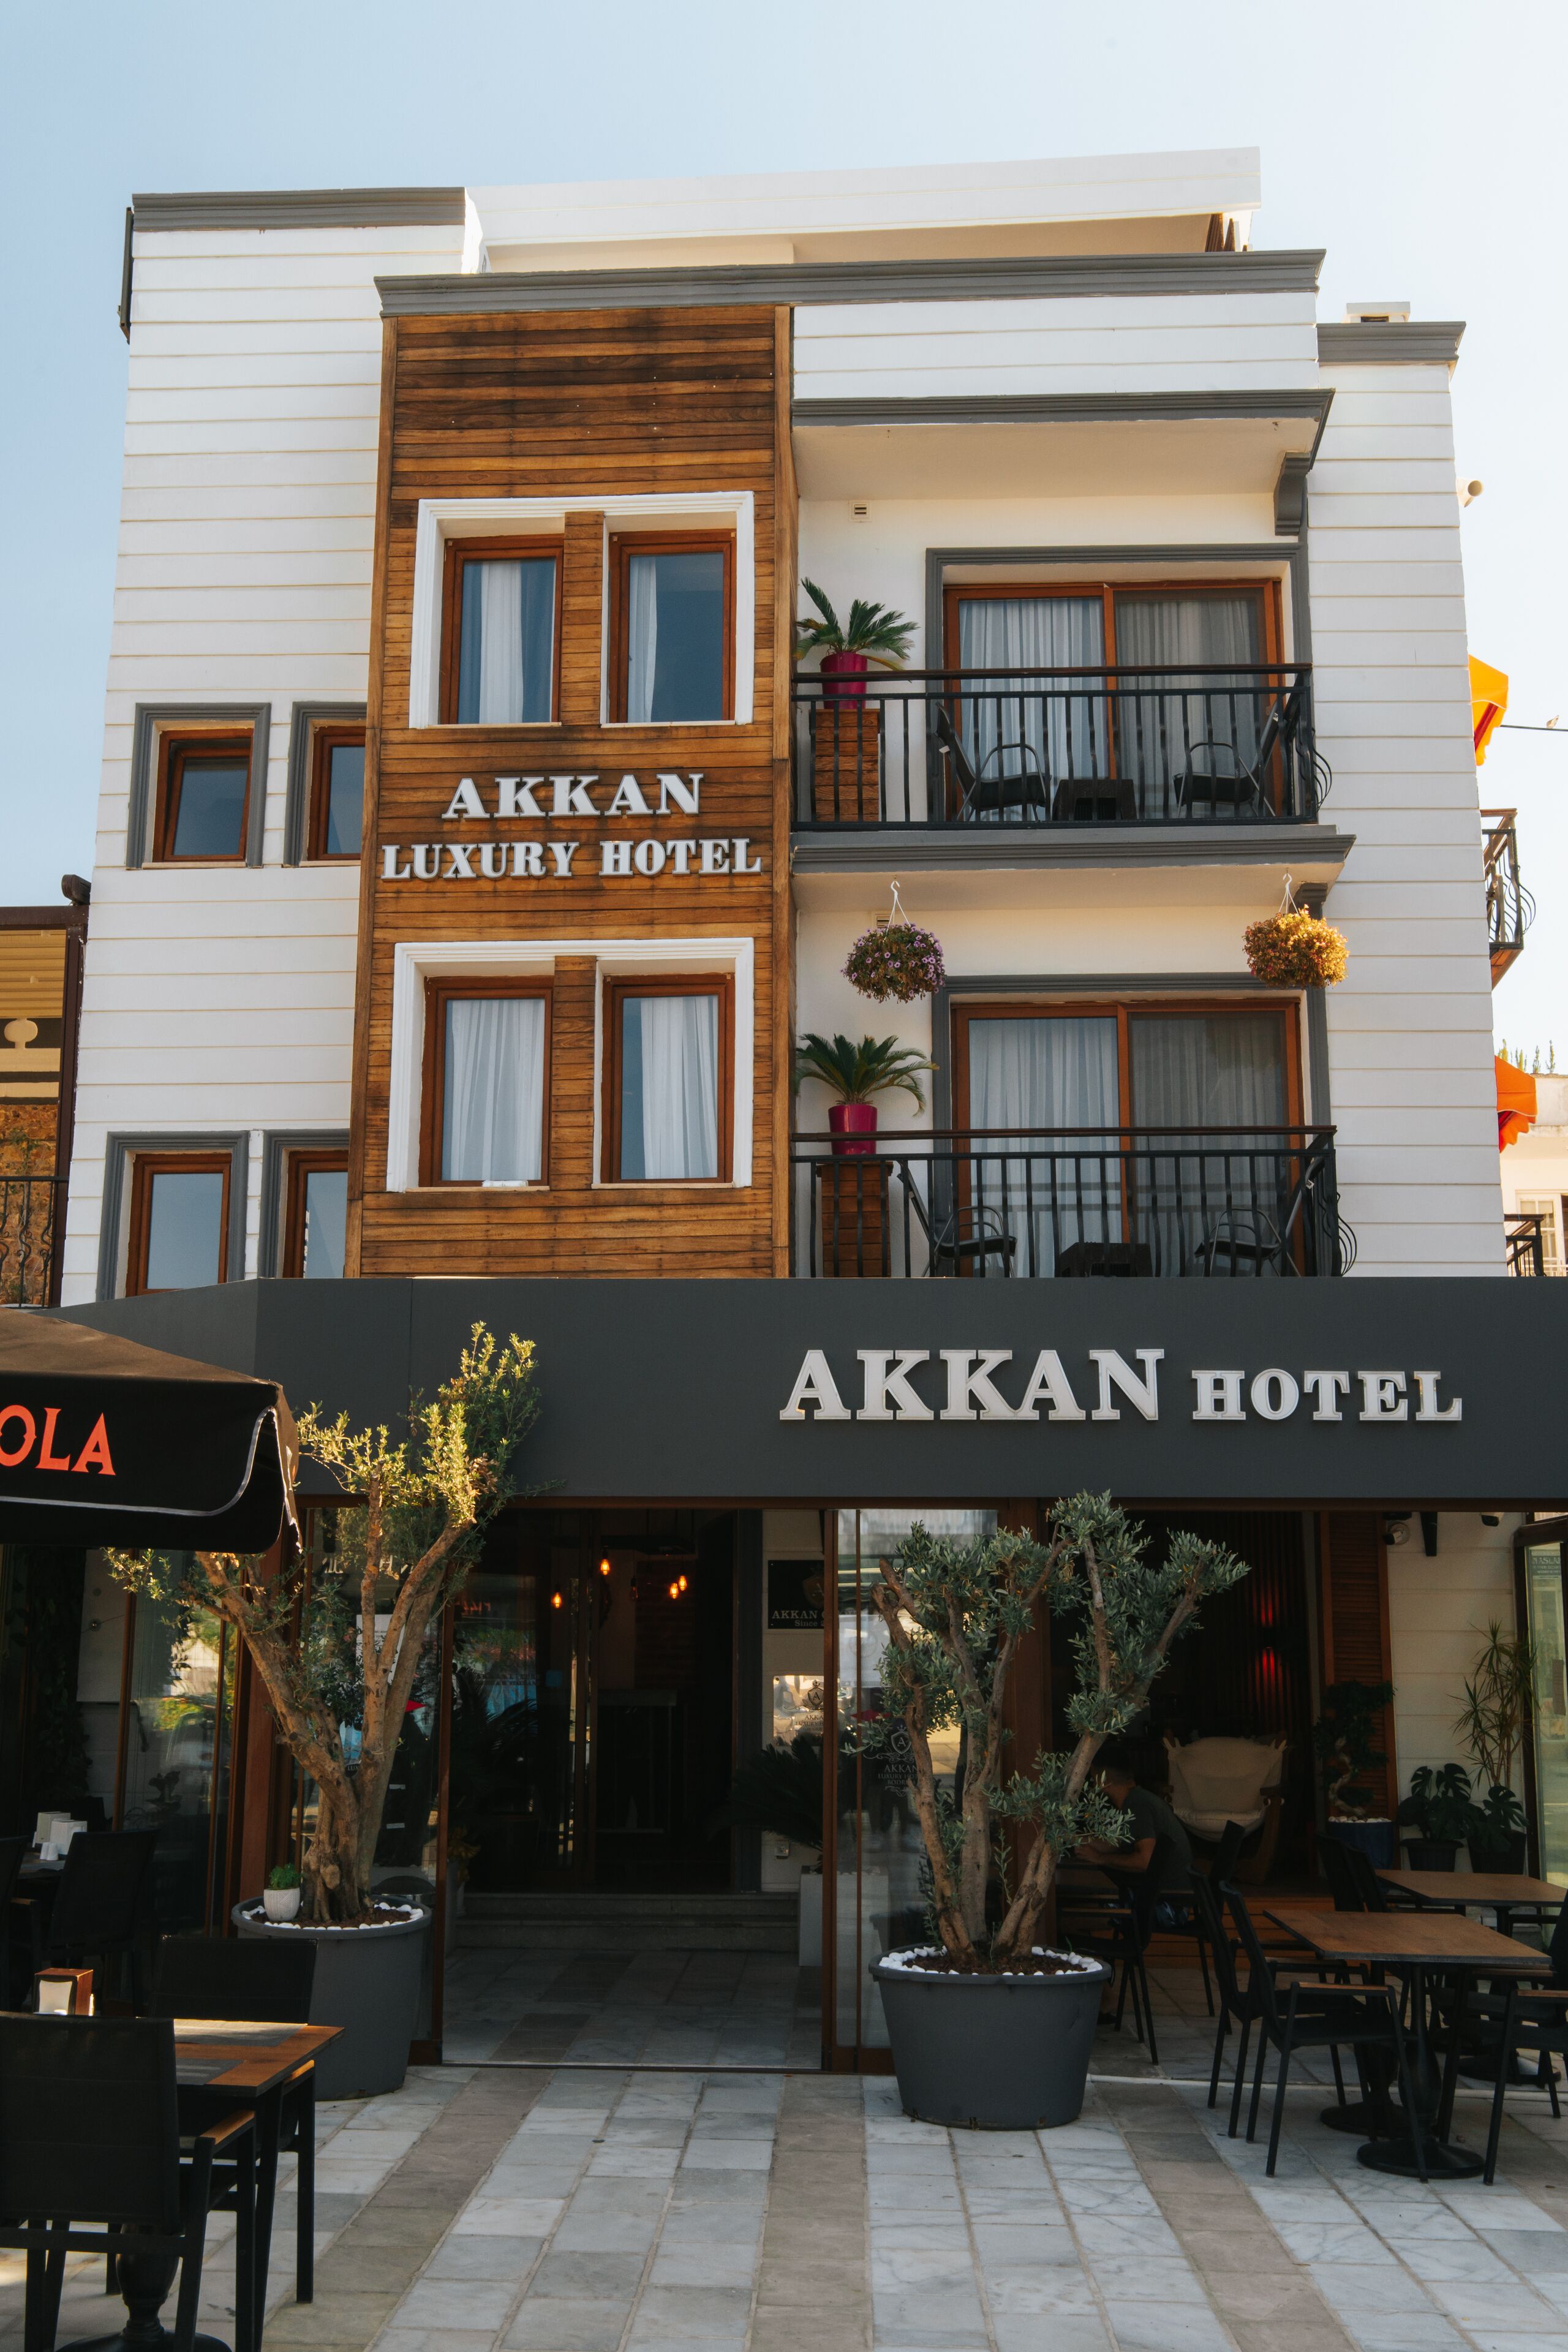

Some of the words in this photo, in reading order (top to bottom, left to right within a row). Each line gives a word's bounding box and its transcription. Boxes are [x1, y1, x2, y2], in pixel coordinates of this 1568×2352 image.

[441, 773, 704, 819] AKKAN
[380, 842, 579, 880] LUXURY
[599, 838, 761, 876] HOTEL
[779, 1348, 1165, 1421] AKKAN
[1191, 1368, 1463, 1421] HOTEL
[0, 1404, 116, 1476] OLA
[772, 1610, 818, 1619] AKKAN
[897, 1737, 906, 1747] A
